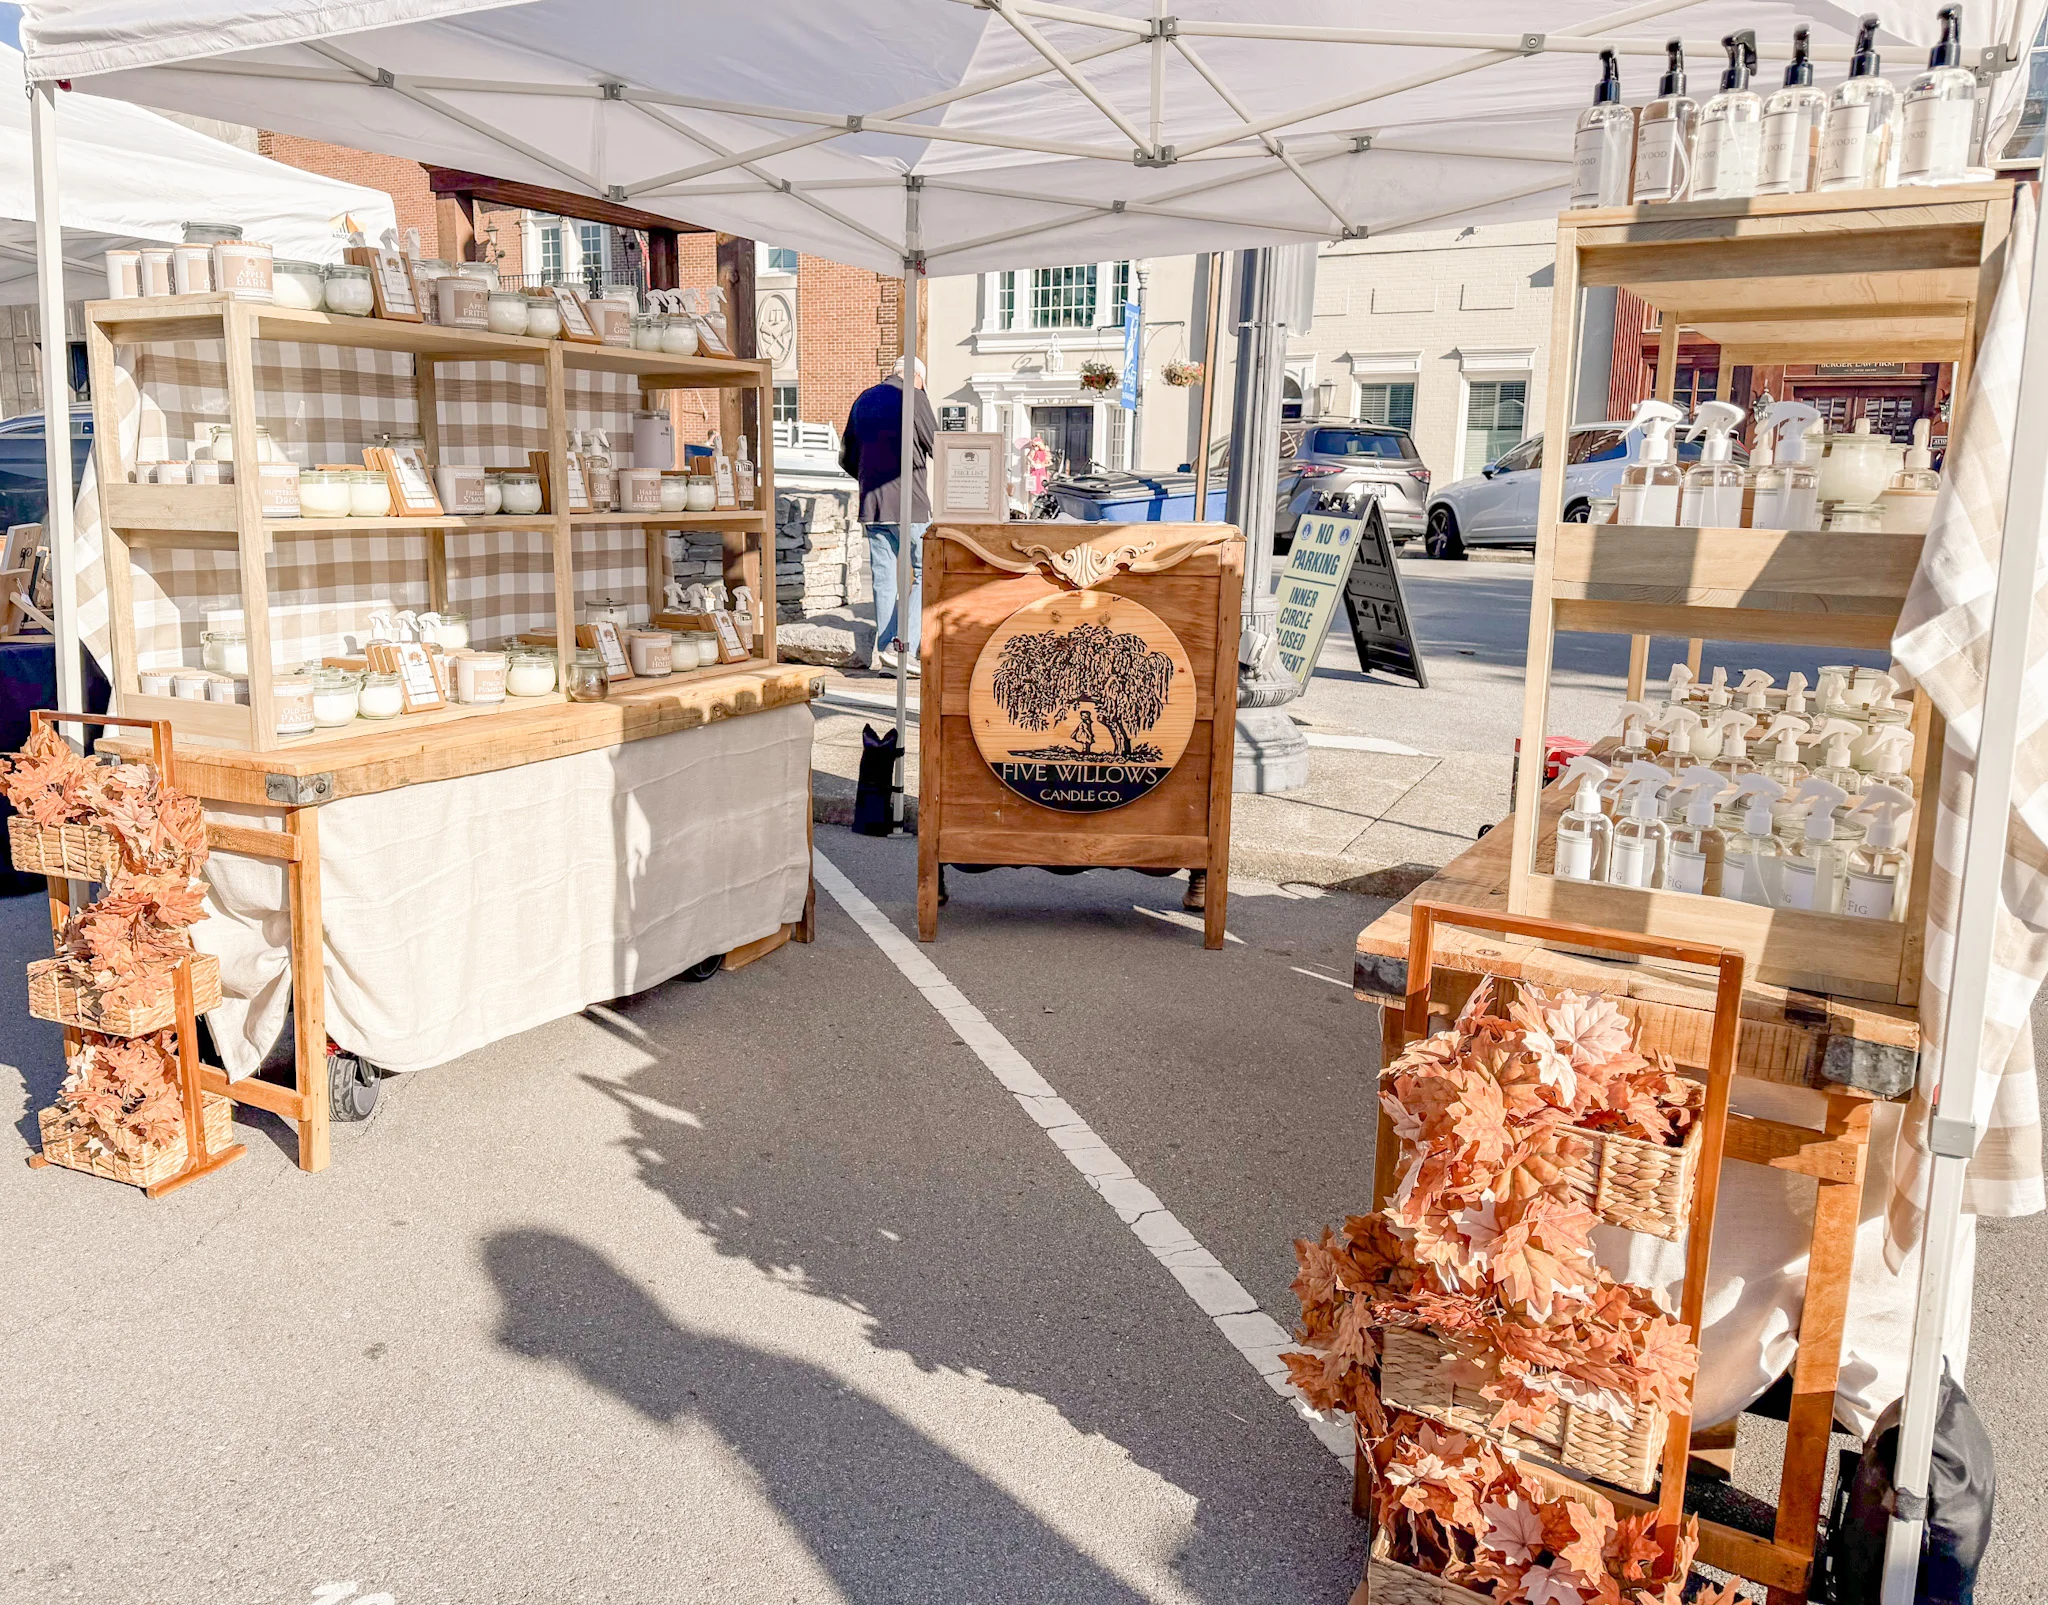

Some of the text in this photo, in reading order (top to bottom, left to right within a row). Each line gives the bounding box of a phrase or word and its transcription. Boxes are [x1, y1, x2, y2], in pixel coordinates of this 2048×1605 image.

[236, 277, 267, 288] BARN
[1315, 523, 1335, 545] NO
[1291, 549, 1341, 576] PARKING
[1288, 586, 1319, 608] INNER
[1279, 607, 1313, 630] CIRCLE
[1002, 762, 1158, 785] FIVE WILLOWS
[1039, 788, 1123, 803] CANDLE CO.
